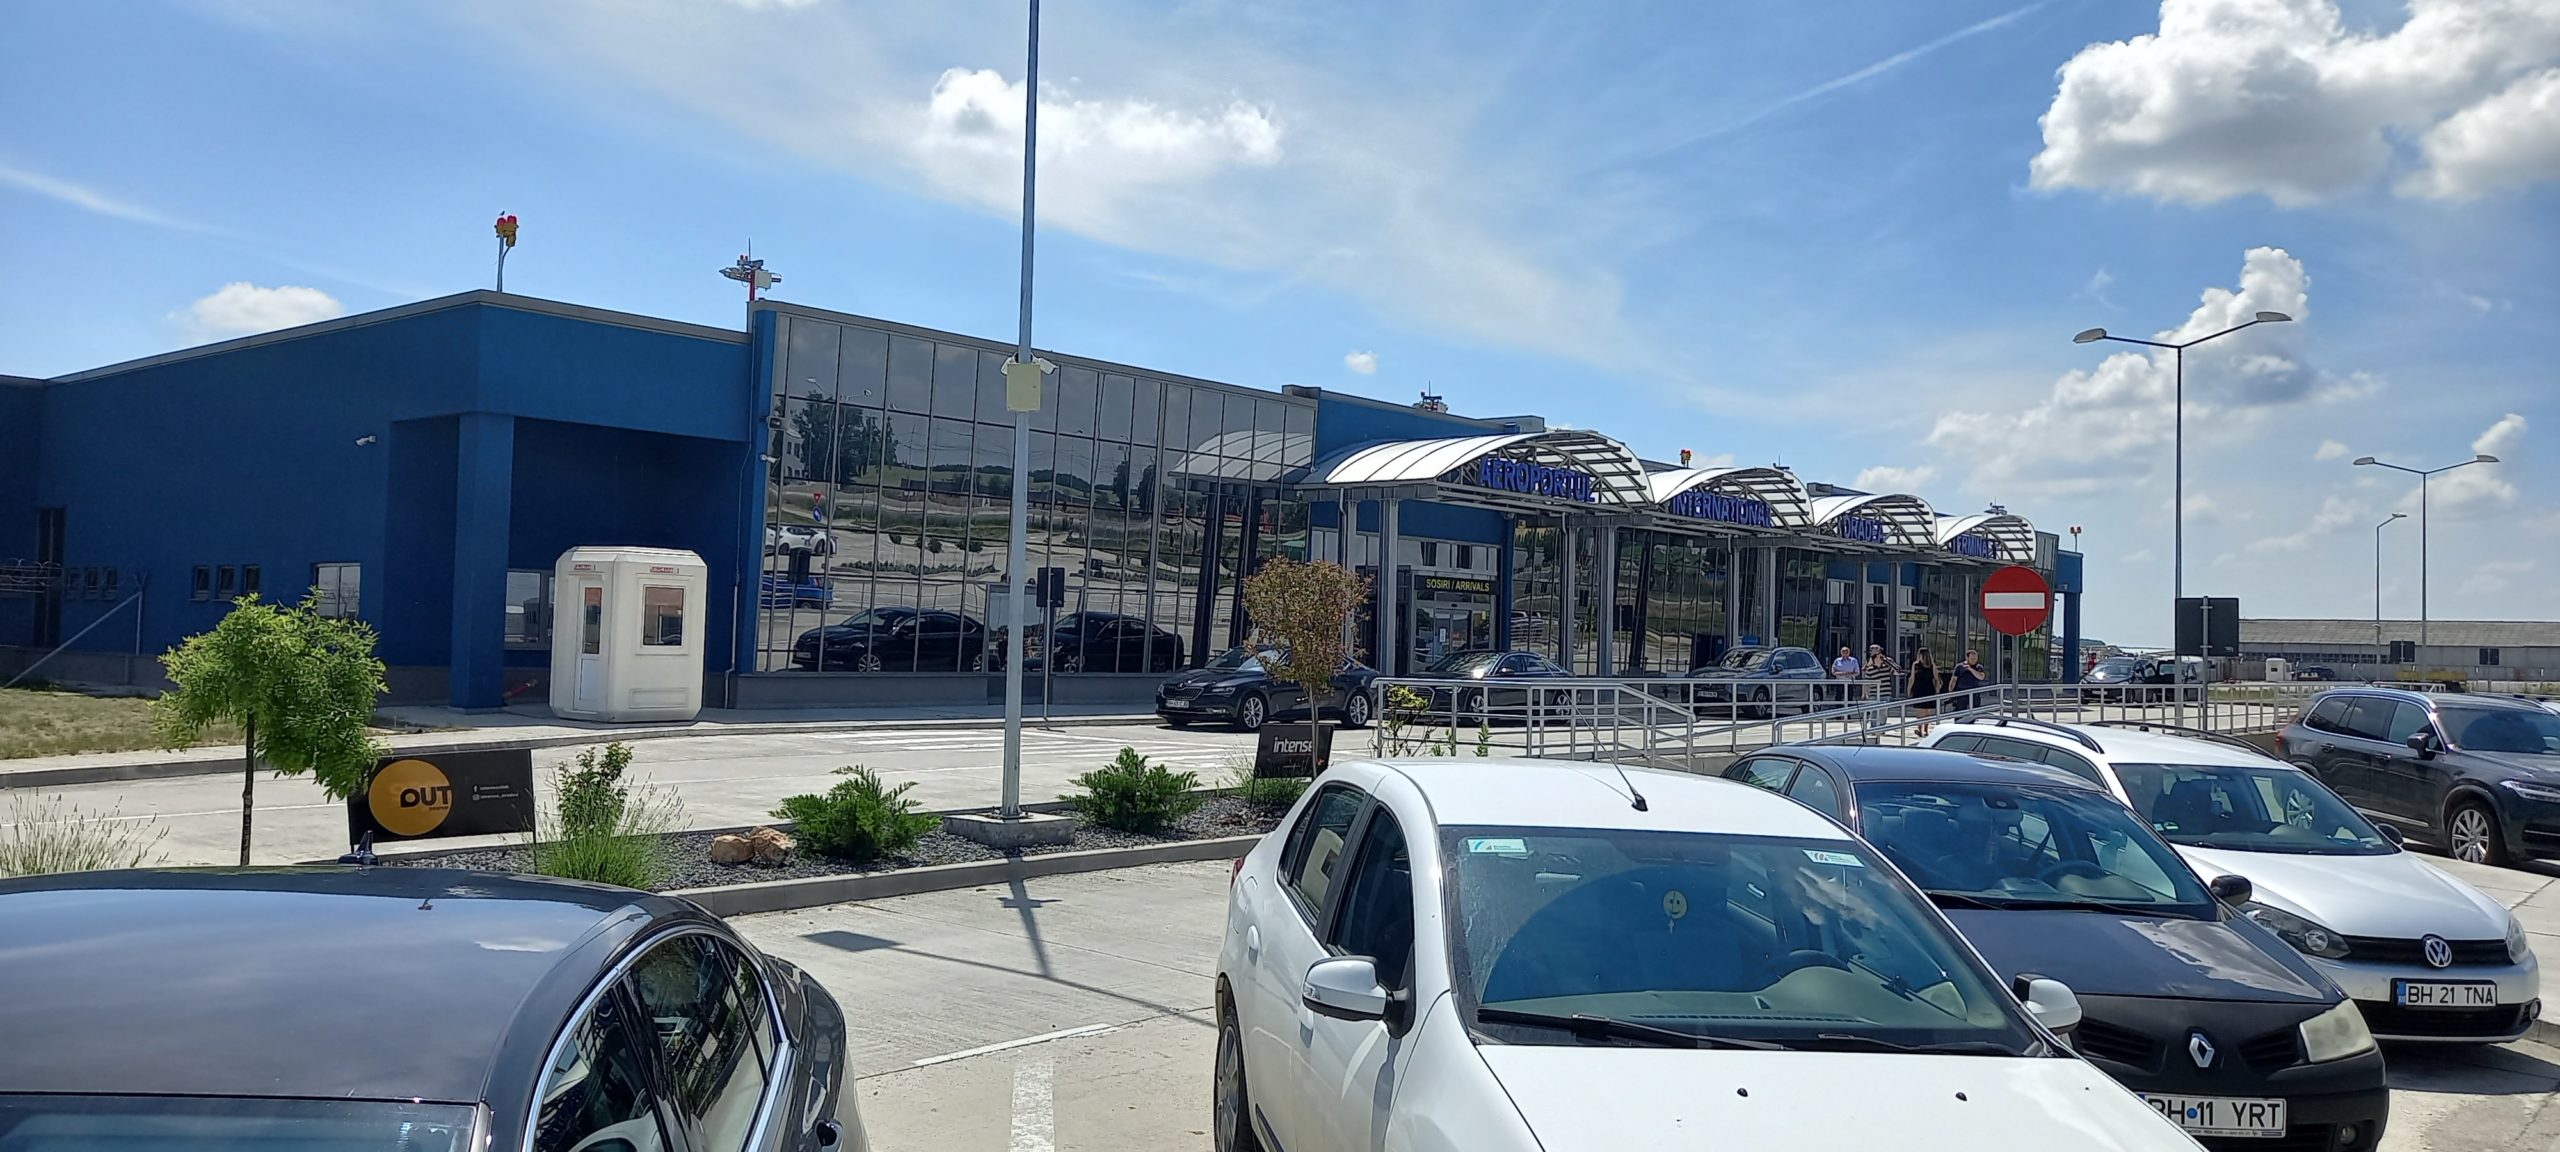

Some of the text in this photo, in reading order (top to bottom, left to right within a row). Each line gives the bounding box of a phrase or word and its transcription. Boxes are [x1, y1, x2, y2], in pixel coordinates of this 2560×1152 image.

[1479, 455, 1596, 503] AEROPORTUL
[1671, 491, 1772, 528] INTERNATIONAL
[1842, 513, 1888, 544] ORADEA
[1426, 578, 1451, 590] SOSIRI
[1455, 580, 1490, 592] ARRIVALS
[400, 785, 451, 808] OUT
[2407, 985, 2494, 1005] BH 21 TNA
[2197, 1101, 2214, 1126] 11
[2231, 1102, 2281, 1128] YRT
